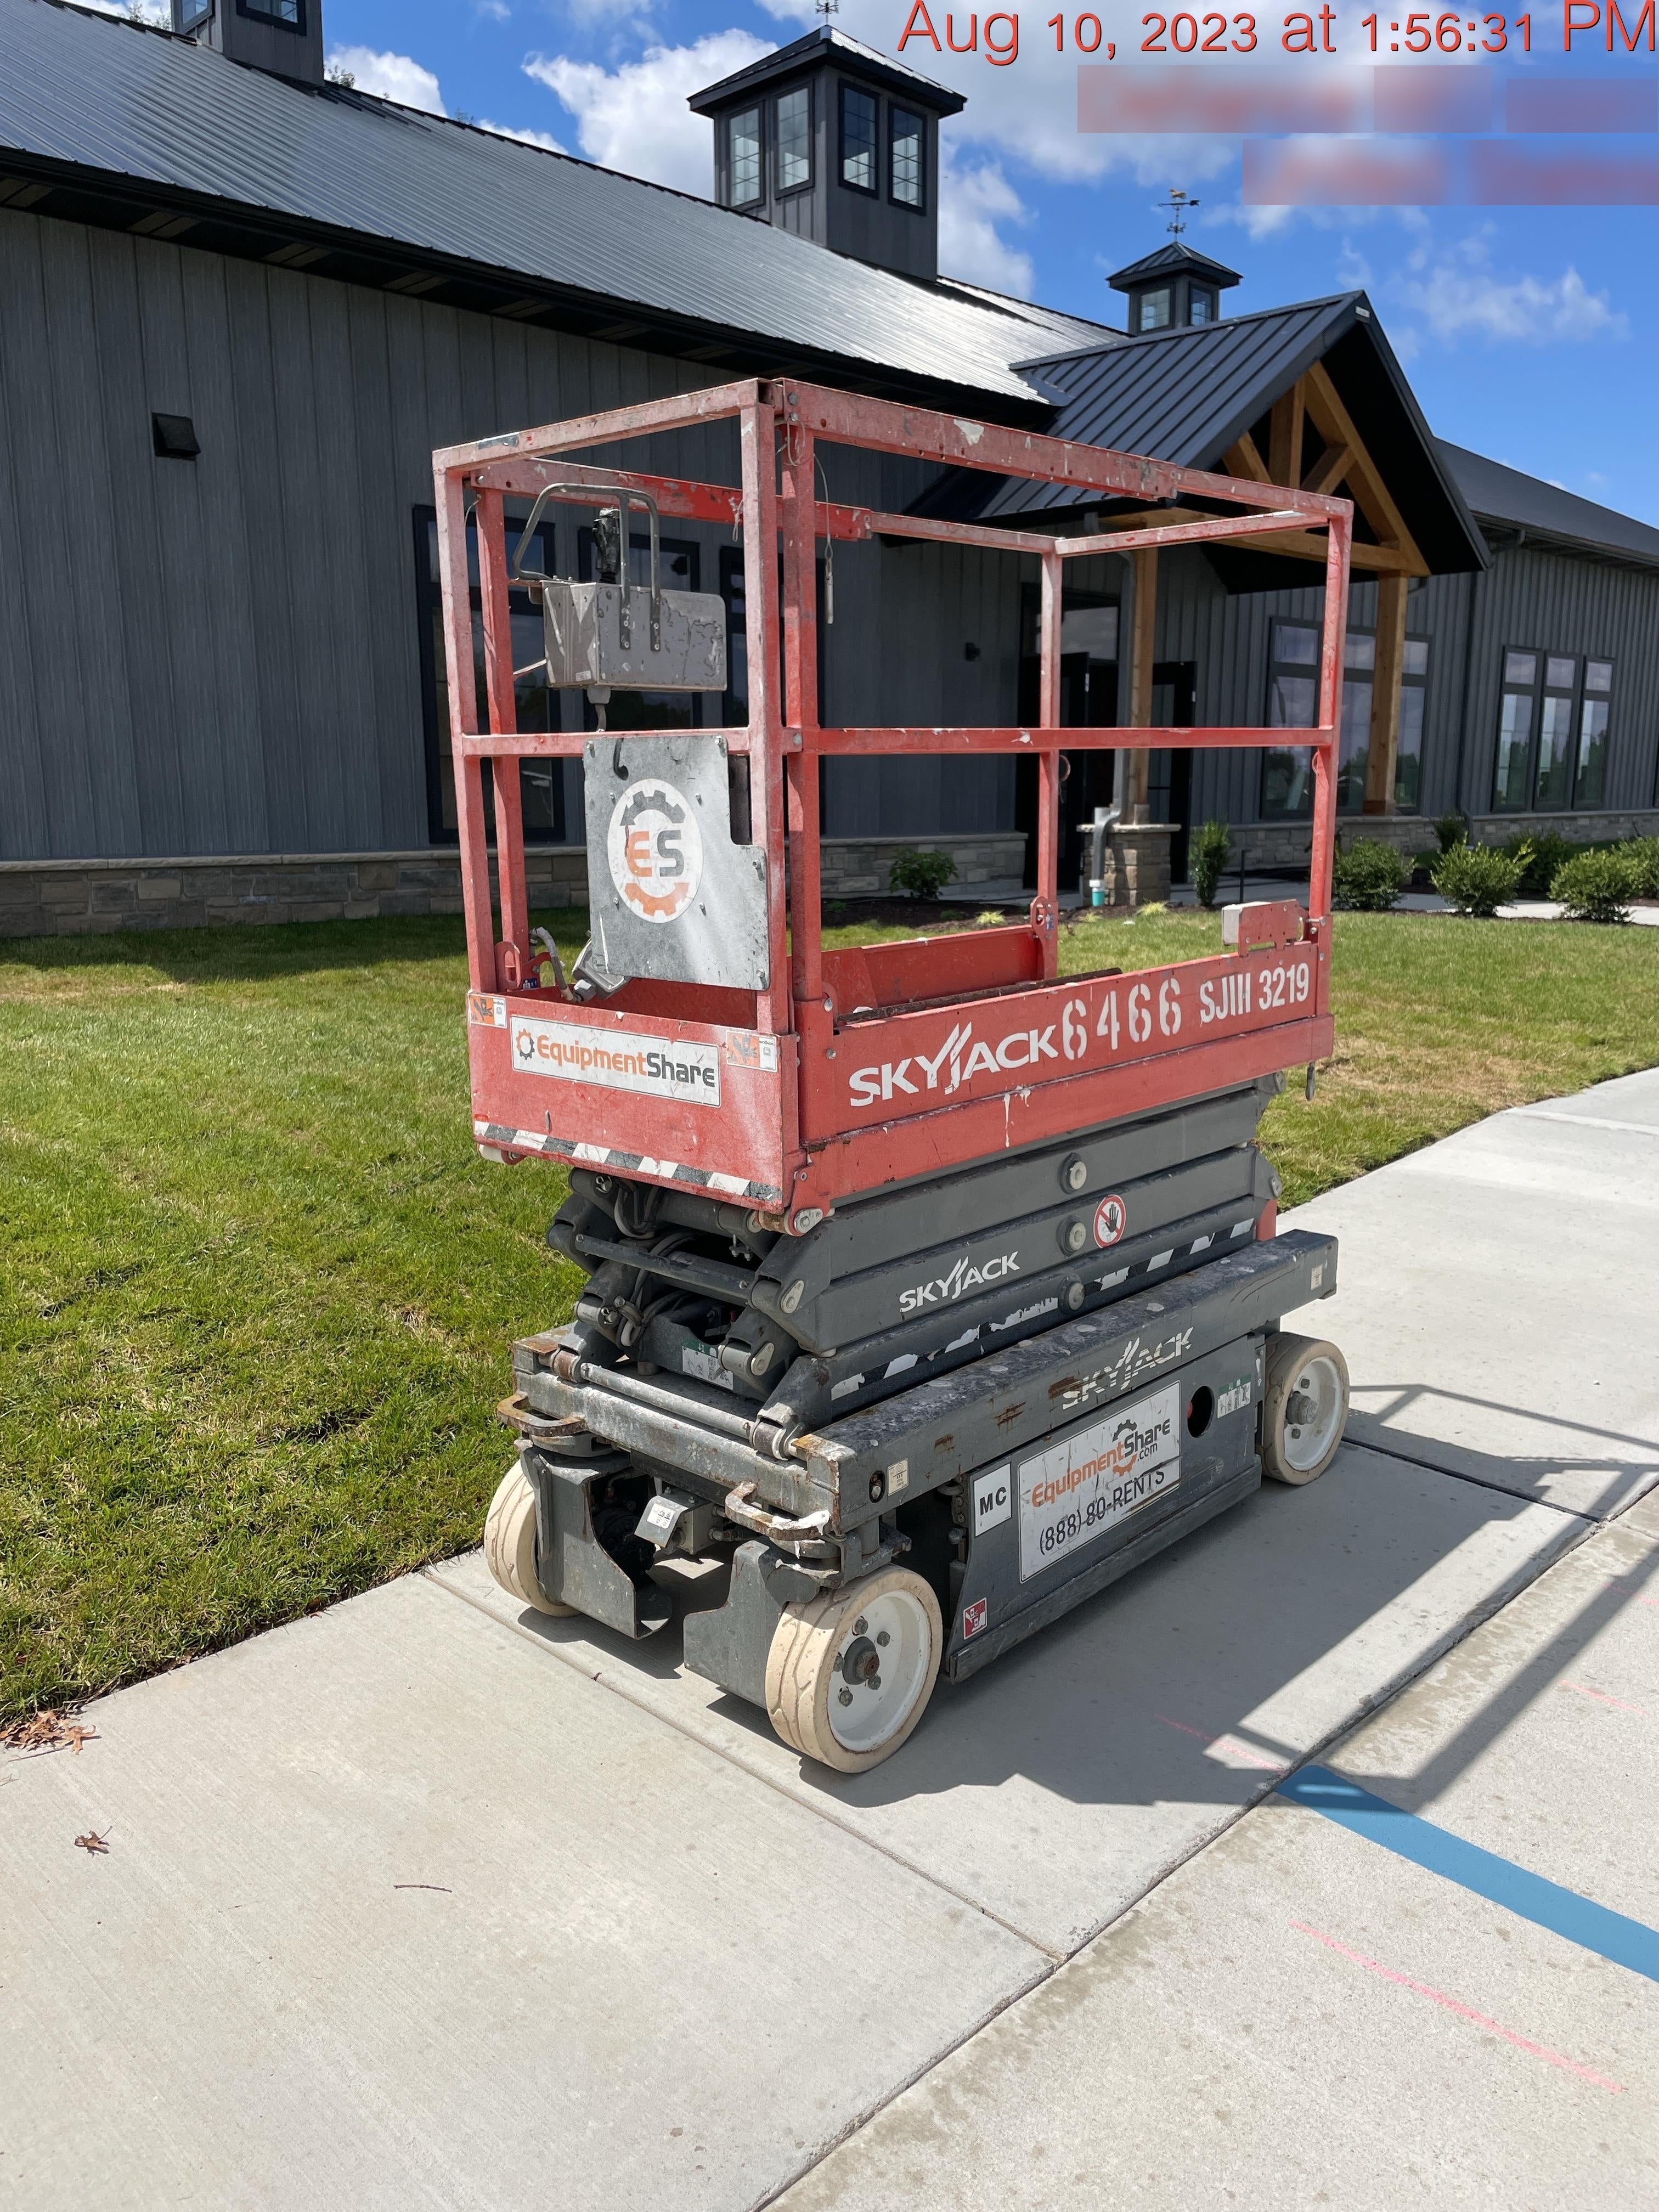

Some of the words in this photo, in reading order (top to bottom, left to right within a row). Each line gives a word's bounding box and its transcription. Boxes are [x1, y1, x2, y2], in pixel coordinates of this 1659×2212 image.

[625, 830, 684, 877] ES
[1259, 962, 1310, 1010] 3219
[537, 1034, 715, 1088] EquipmentShare
[849, 1022, 1059, 1107] SKYJACK
[1062, 978, 1181, 1060] 6466
[899, 1251, 1020, 1312] SKYJACK
[1031, 1418, 1170, 1508] EquipmentShare
[1137, 1443, 1158, 1462] .com
[980, 1486, 1007, 1516] MC
[1040, 1509, 1081, 1556] (888)
